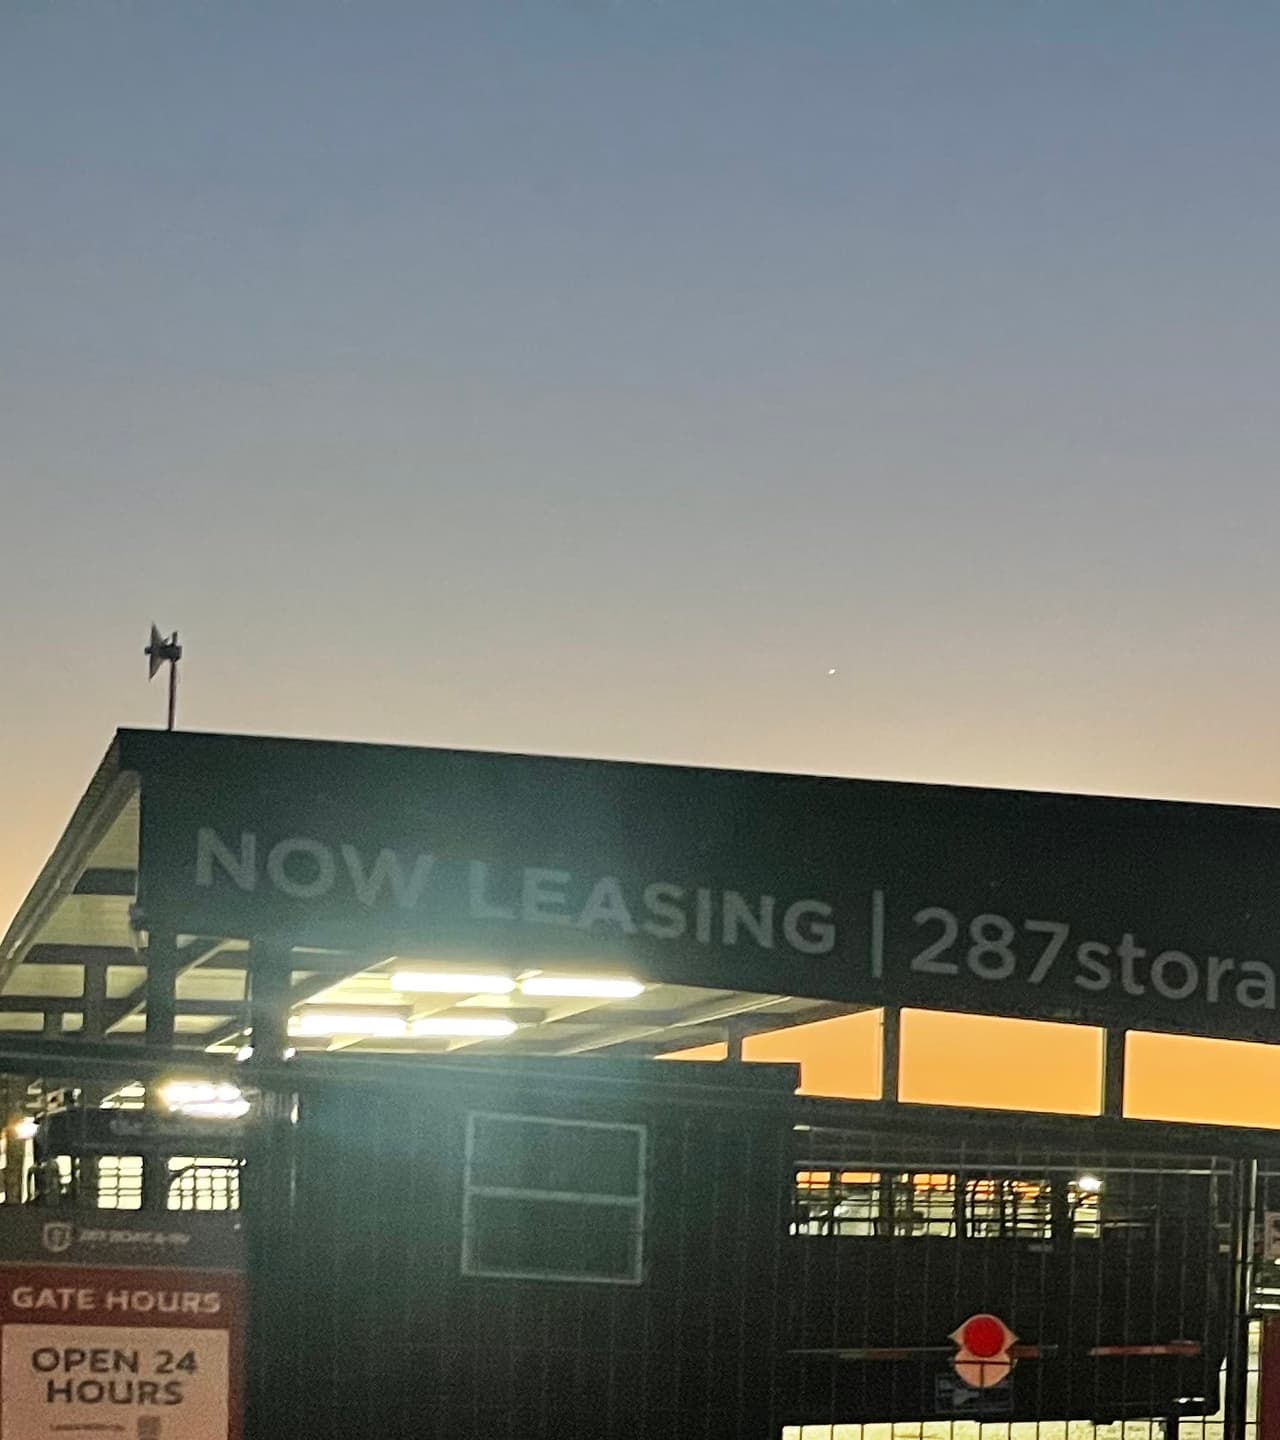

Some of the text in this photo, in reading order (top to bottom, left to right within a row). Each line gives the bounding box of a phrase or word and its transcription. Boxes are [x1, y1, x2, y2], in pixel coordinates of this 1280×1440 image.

[195, 827, 435, 906] NOW
[466, 858, 836, 955] LEASING
[12, 1286, 222, 1314] GATE HOURS
[31, 1347, 198, 1375] OPEN 24
[46, 1378, 185, 1406] HOURS
